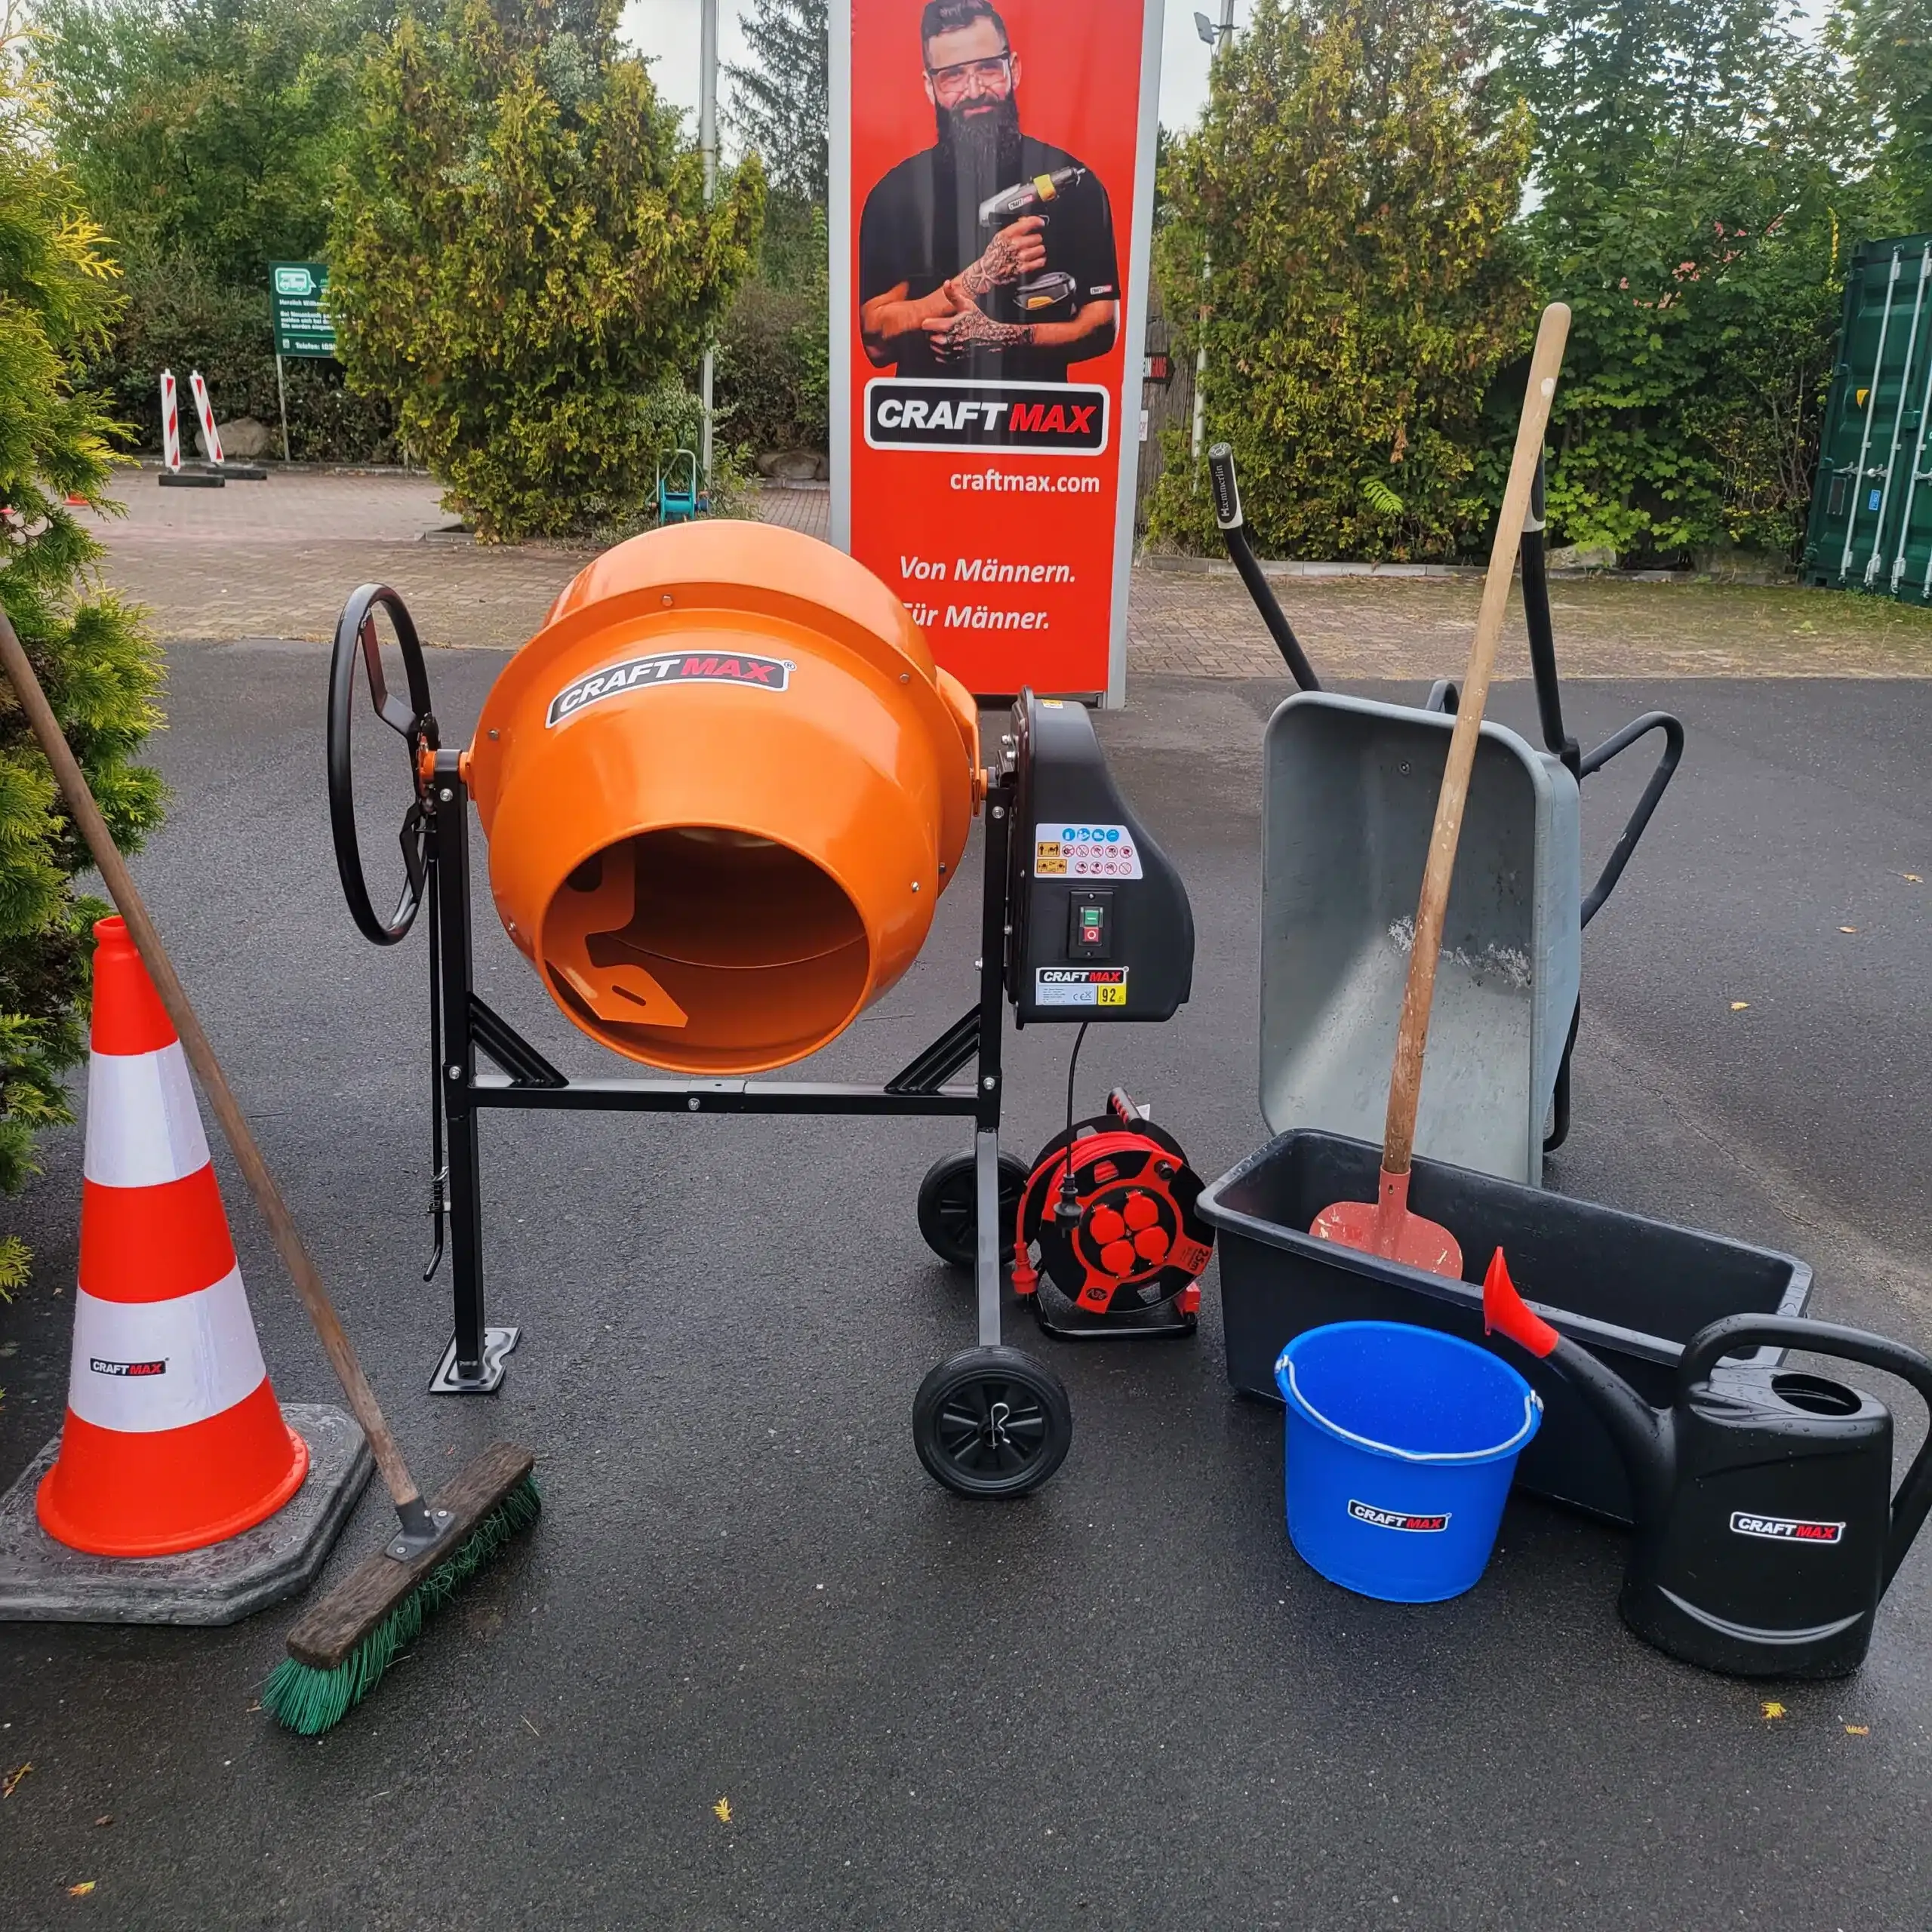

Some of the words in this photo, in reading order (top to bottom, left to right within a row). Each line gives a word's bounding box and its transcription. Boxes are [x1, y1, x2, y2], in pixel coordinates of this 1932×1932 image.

[950, 469, 1100, 493] craftmax.com
[900, 555, 946, 580] Von
[953, 558, 1076, 583] Männern.
[943, 605, 1050, 629] Männer.
[1102, 988, 1116, 1002] 92
